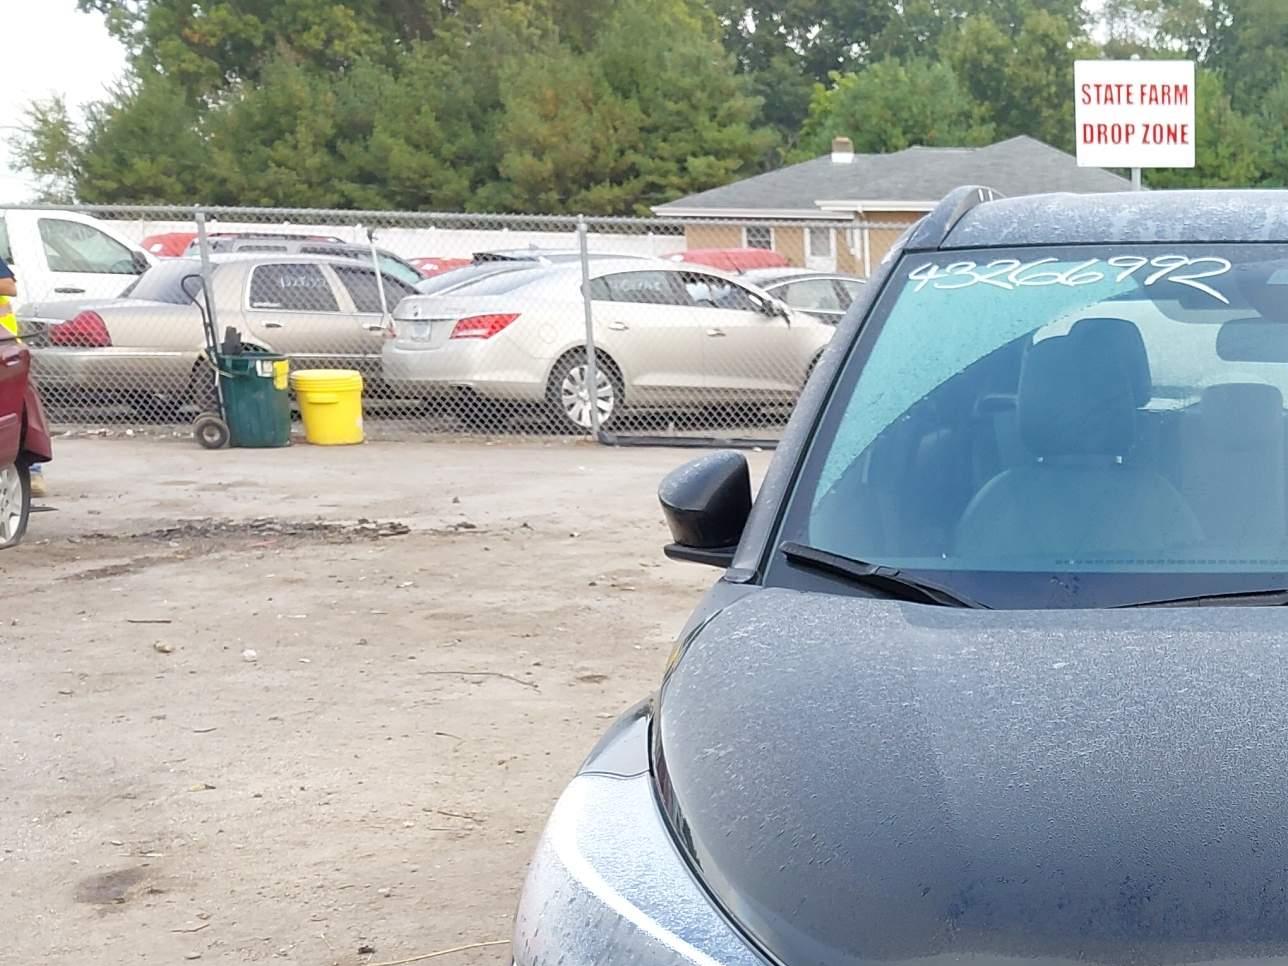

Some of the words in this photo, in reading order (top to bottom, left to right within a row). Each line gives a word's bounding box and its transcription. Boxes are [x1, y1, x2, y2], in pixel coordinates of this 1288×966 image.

[1081, 83, 1134, 105] STATE
[1140, 83, 1188, 105] FARM
[1082, 123, 1136, 145] DROP
[1141, 123, 1190, 145] ZONE
[908, 255, 1232, 304] 43266992
